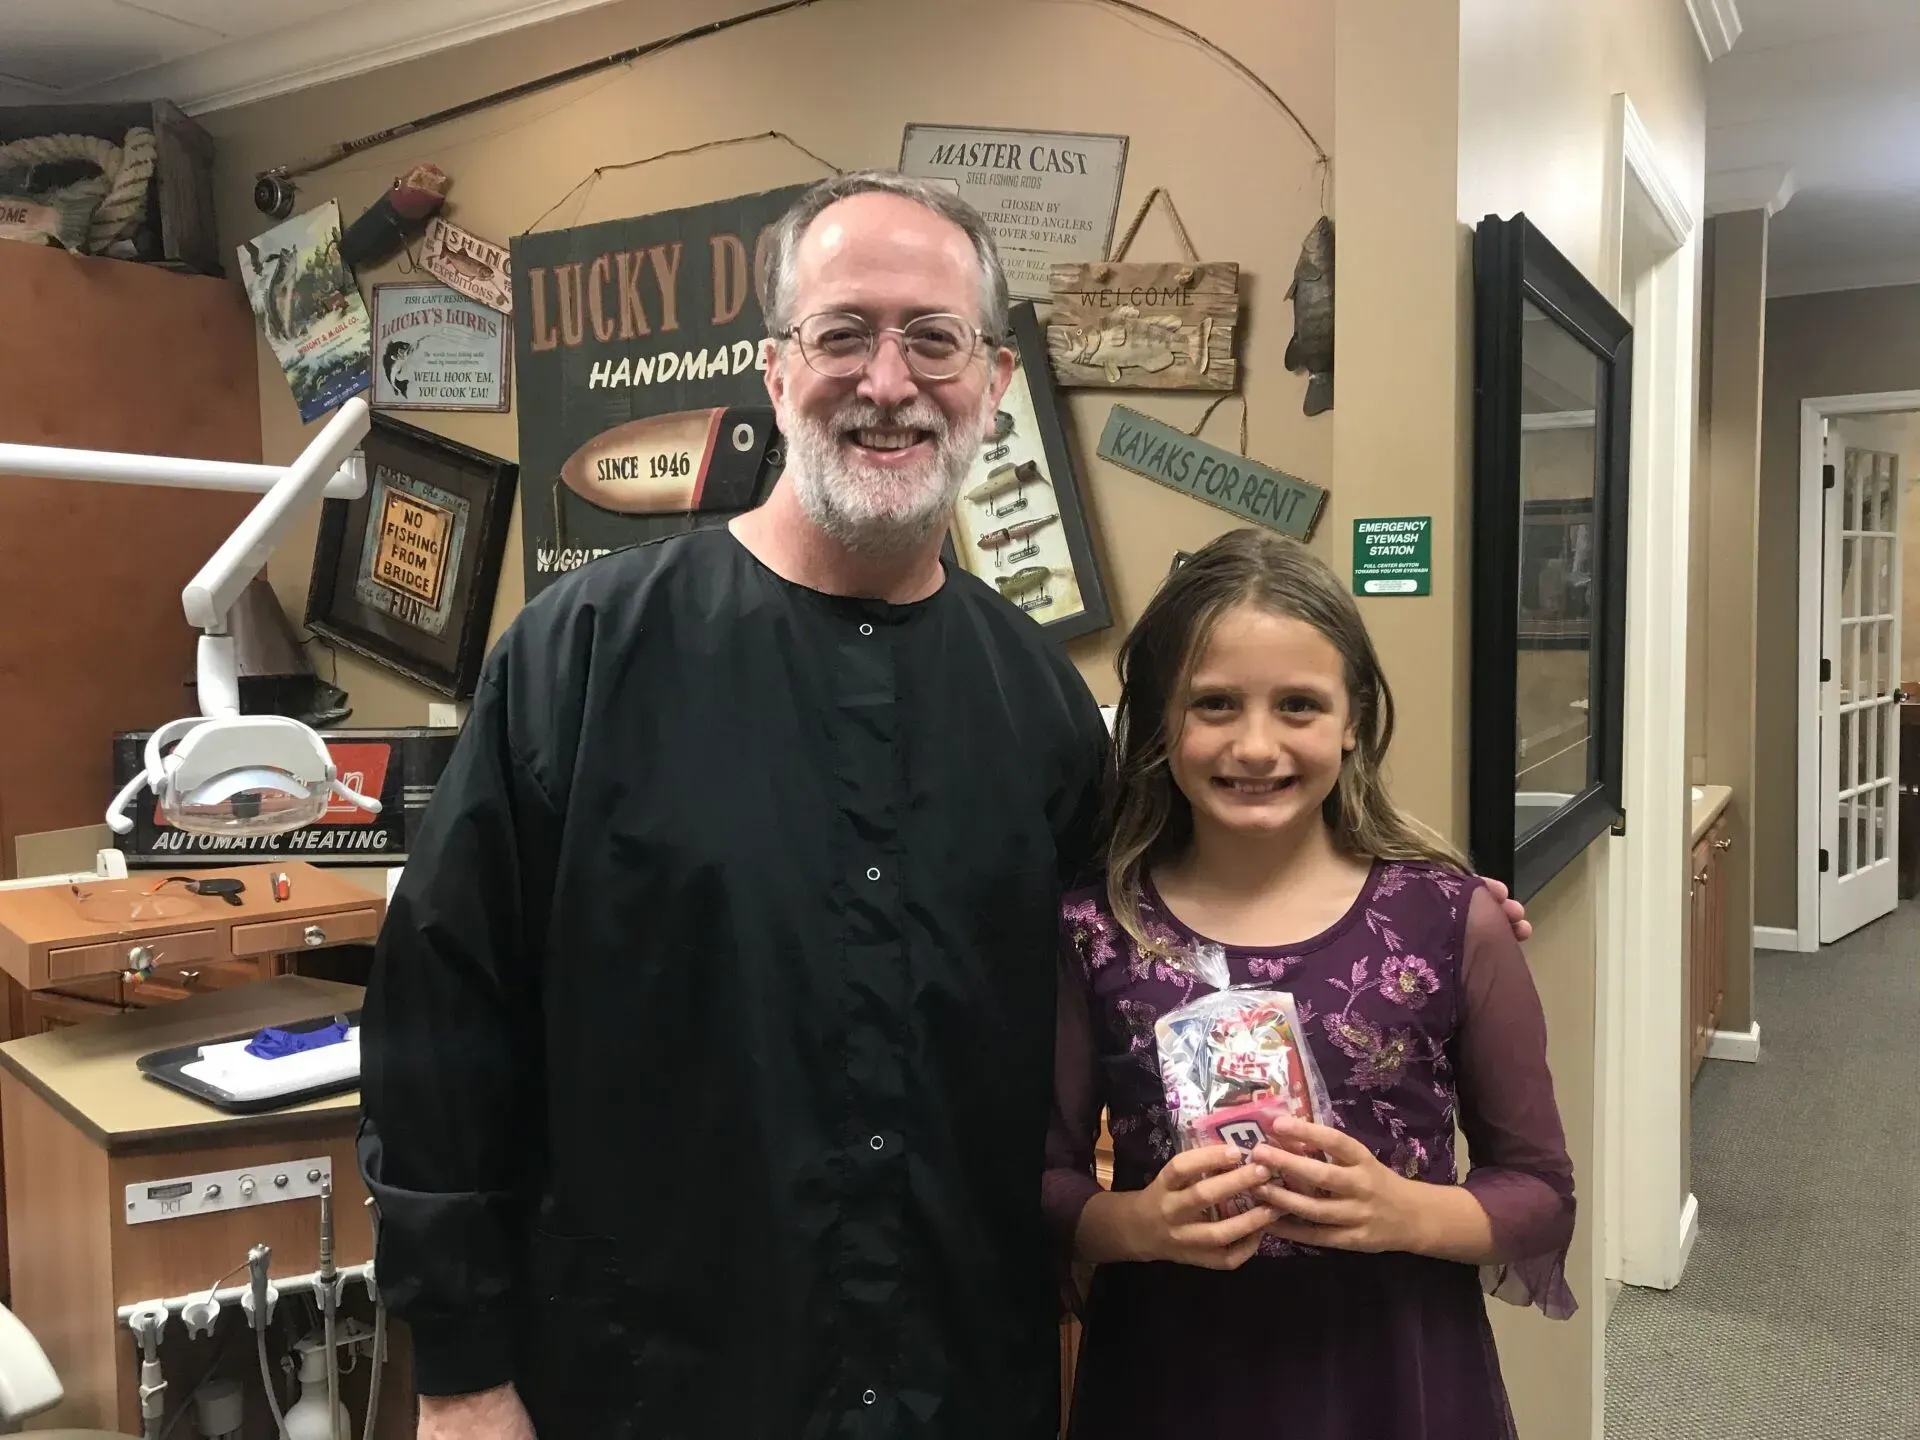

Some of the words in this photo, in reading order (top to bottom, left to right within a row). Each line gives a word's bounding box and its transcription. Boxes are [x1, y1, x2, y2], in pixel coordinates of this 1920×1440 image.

[929, 142, 1022, 170] MASTER
[1029, 146, 1089, 174] CAST
[966, 172, 987, 186] STEEL
[989, 173, 1018, 188] FISHING
[1020, 175, 1043, 190] RODS
[1001, 199, 1044, 212] CHOSEN
[1046, 202, 1061, 213] BY
[980, 211, 1040, 226] PERIENCED
[1041, 217, 1094, 231] ANGLERS
[999, 227, 1027, 240] OVER
[1030, 231, 1041, 240] 50
[1042, 231, 1077, 245] YEARS
[433, 262, 494, 301] EXPEDITIONS
[404, 296, 421, 305] FISH
[443, 296, 474, 304] RESIS
[528, 242, 684, 353] LUCKY
[1080, 286, 1196, 308] WELCOME
[381, 307, 443, 340] LUCKY'S
[446, 308, 498, 339] LURES
[297, 337, 321, 354] WRIGHT
[588, 339, 776, 390] HANDMADE
[413, 371, 441, 383] WE'LL
[444, 371, 472, 383] HOOK
[418, 387, 438, 398] YOU
[440, 387, 466, 398] COOK
[597, 455, 639, 482] SINCE
[650, 451, 691, 479] 1946
[1110, 422, 1196, 482] KAYAKS
[1191, 455, 1240, 502] FOR
[1237, 473, 1307, 524] RENT
[403, 508, 423, 529] NO
[1358, 521, 1428, 533] EMERGENCY
[387, 522, 438, 556] FISHING
[1365, 533, 1420, 545] EYEWASH
[391, 543, 427, 571] FROM
[1369, 545, 1416, 556] STATION
[383, 561, 430, 593] BRIDGE
[389, 591, 423, 625] FUN
[151, 831, 282, 851] AUTOMATIC
[288, 830, 389, 850] HEATING
